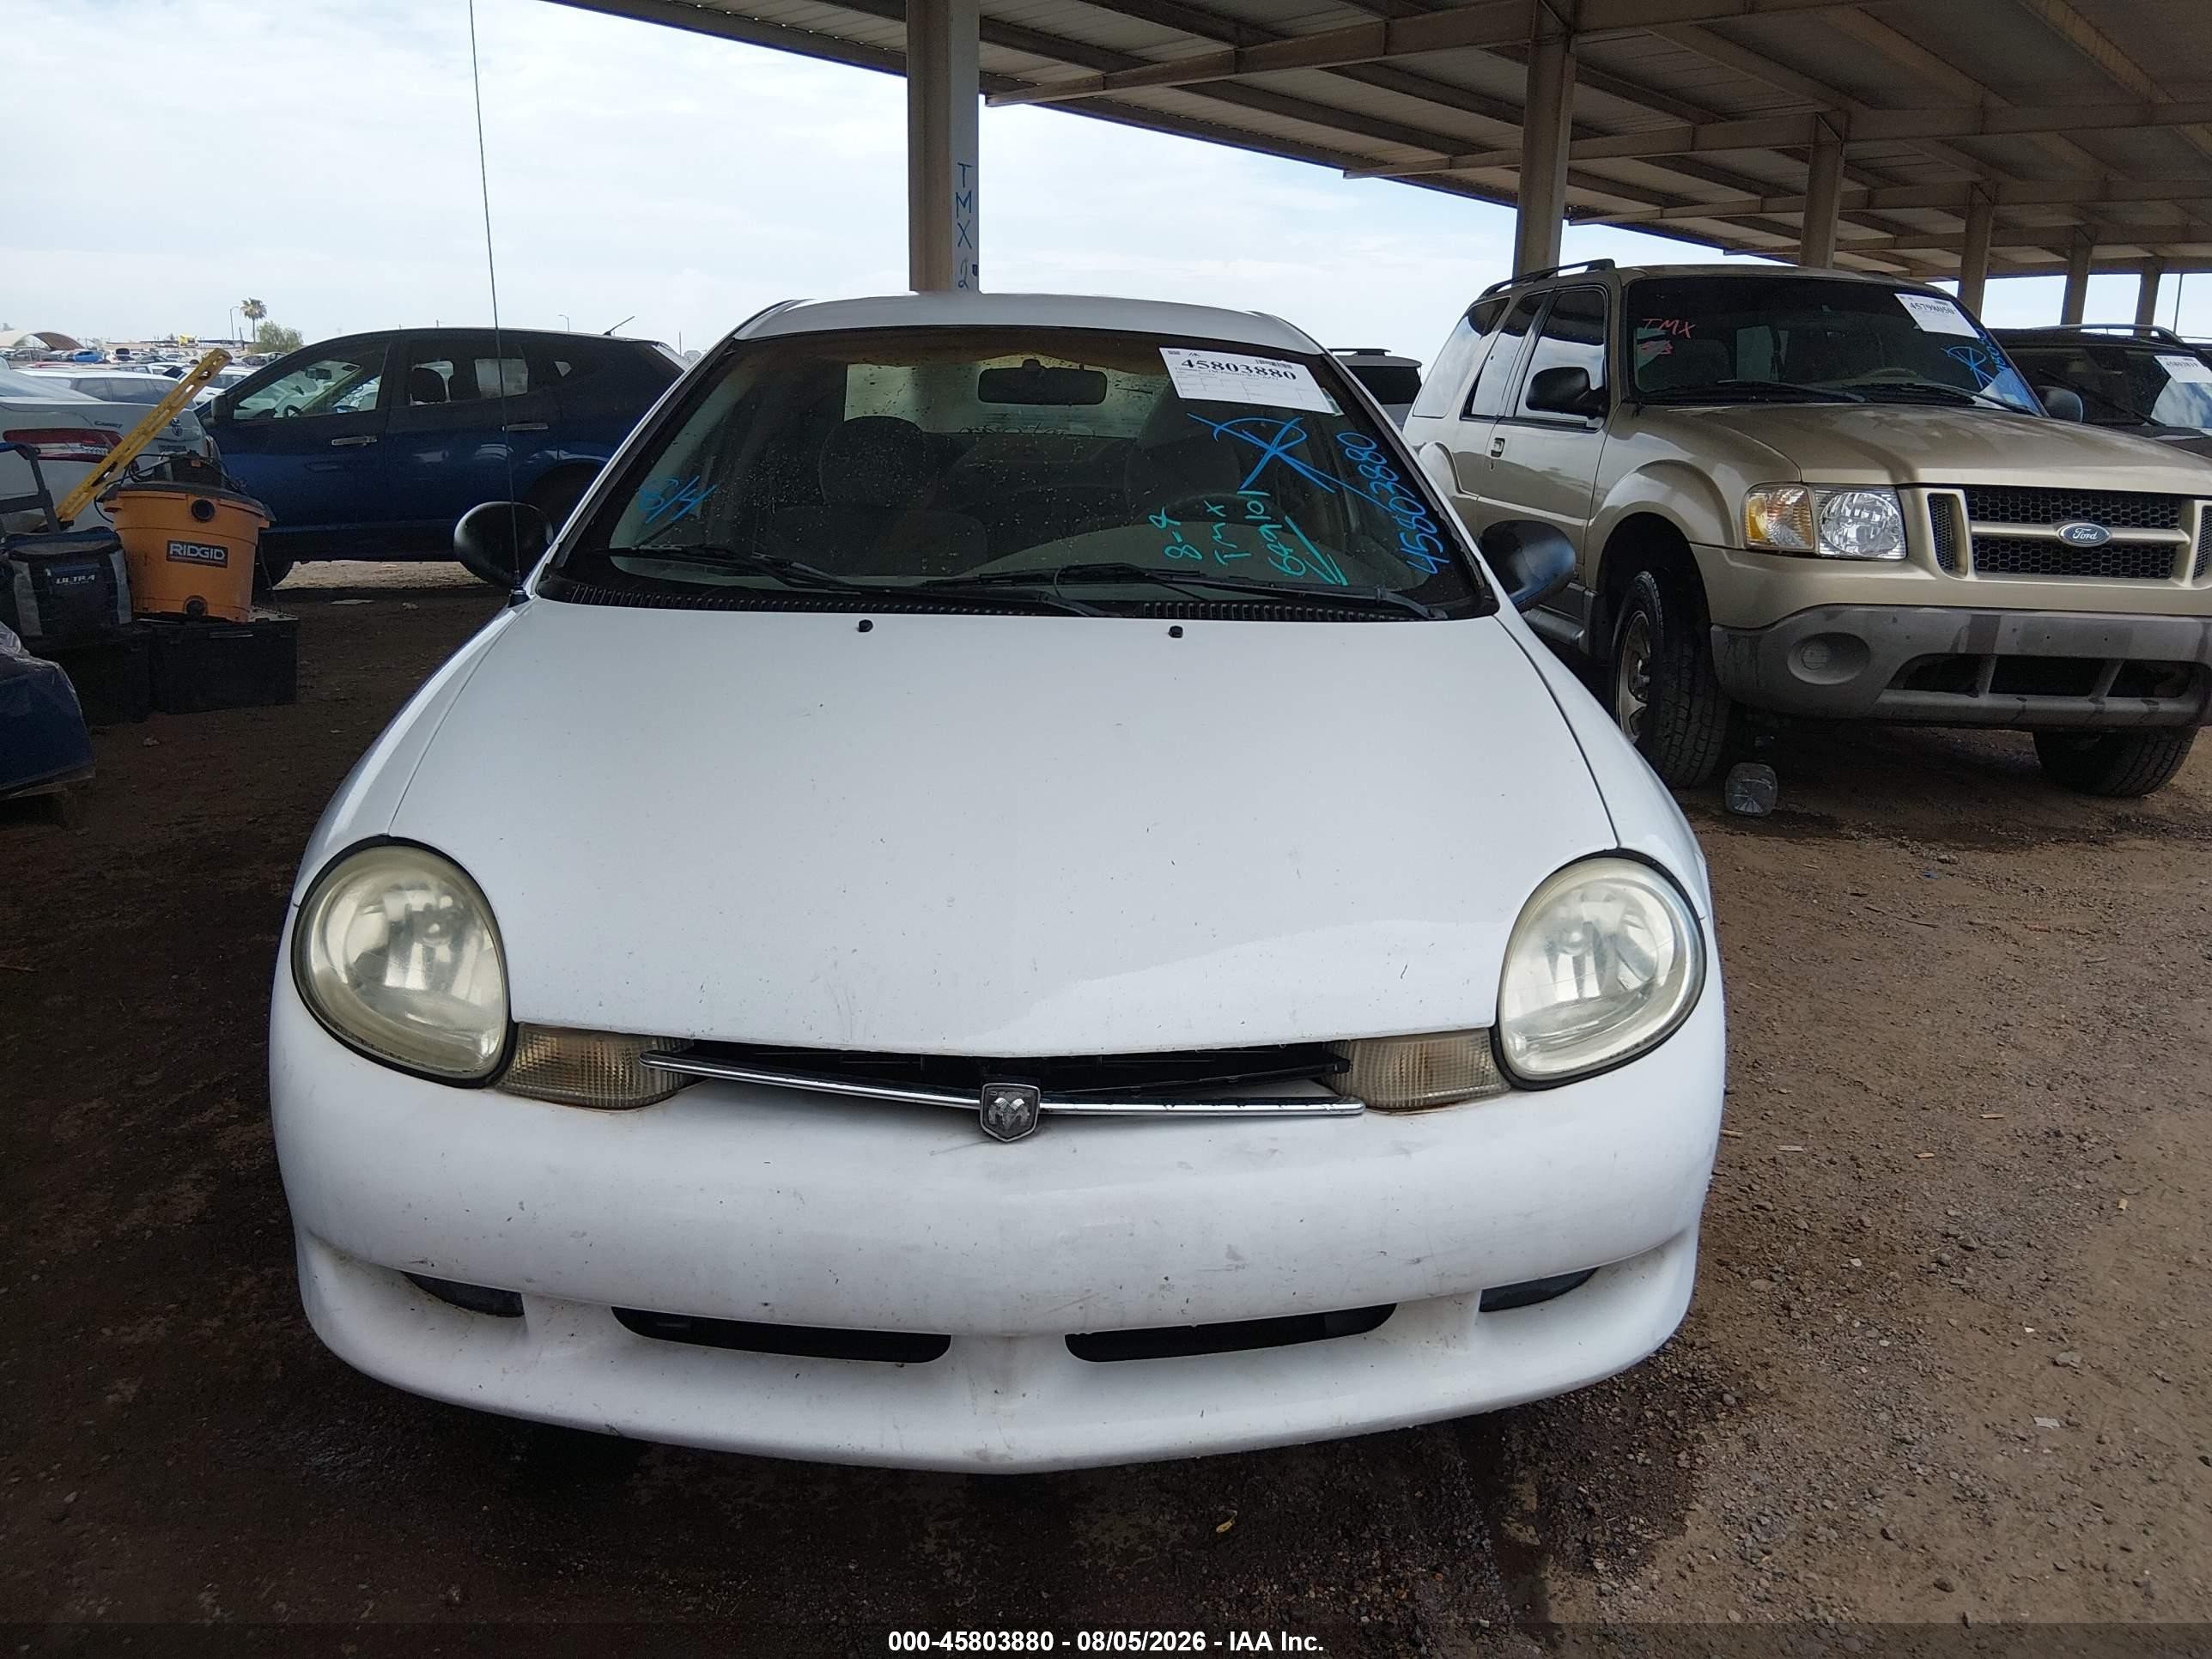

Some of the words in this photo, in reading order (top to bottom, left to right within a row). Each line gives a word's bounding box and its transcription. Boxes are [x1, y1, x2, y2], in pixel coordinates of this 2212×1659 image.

[1642, 318, 1696, 338] TMX
[1181, 358, 1297, 380] 45803880
[1336, 432, 1450, 574] 45803880
[2072, 527, 2099, 540] Ford
[169, 543, 226, 560] RIDGID
